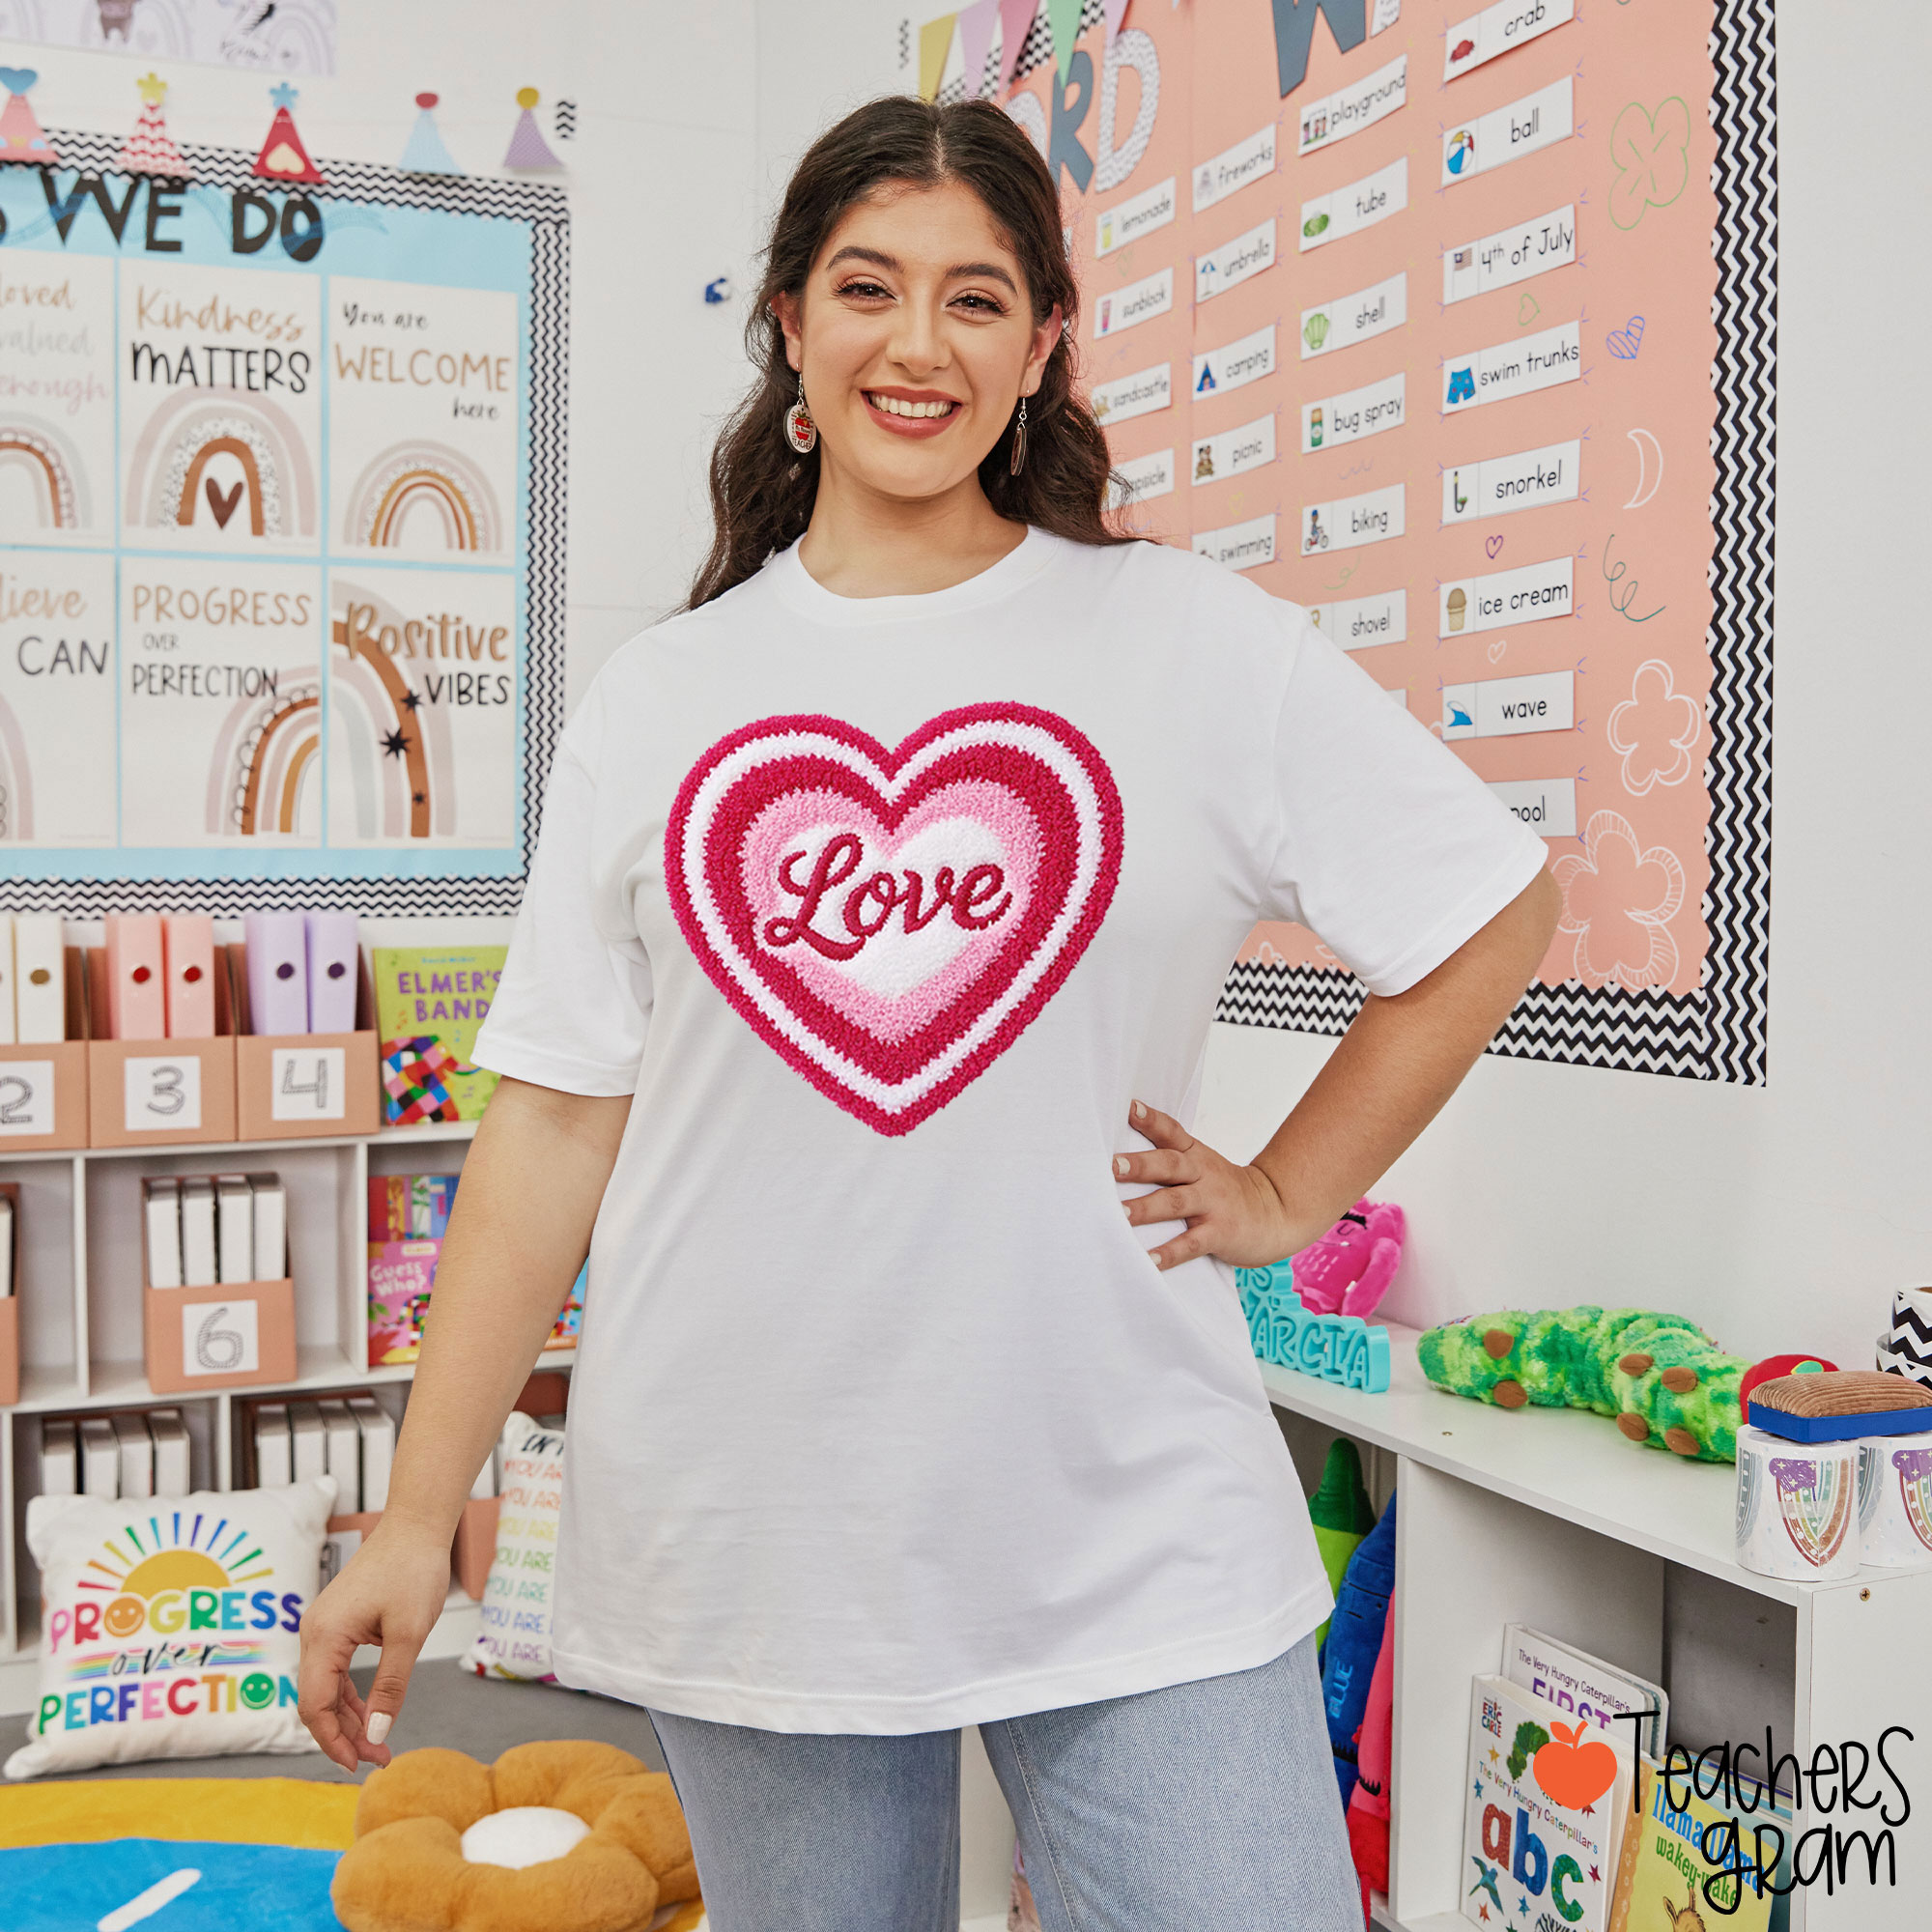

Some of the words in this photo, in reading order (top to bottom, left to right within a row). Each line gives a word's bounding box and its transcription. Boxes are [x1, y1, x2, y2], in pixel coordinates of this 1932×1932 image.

[1505, 0, 1546, 36] crab
[1331, 64, 1406, 131] playground
[1511, 106, 1540, 144] ball
[1218, 142, 1272, 187] fireworks
[39, 172, 186, 252] WE
[232, 191, 324, 262] DO
[1122, 192, 1172, 233] lemonade
[1356, 187, 1387, 217] tube
[1224, 238, 1270, 277] umbrella
[1482, 243, 1504, 273] 4th
[1511, 236, 1531, 266] of
[1537, 223, 1574, 255] July
[136, 286, 304, 342] Kindness
[343, 301, 385, 327] You
[395, 313, 430, 330] are
[1123, 282, 1166, 319] sunblock
[1356, 296, 1386, 329] shell
[131, 342, 310, 394] MATTERS
[335, 343, 512, 392] WELCOME
[1226, 349, 1269, 380] camping
[1480, 363, 1520, 387] swim
[1526, 340, 1578, 374] trunks
[452, 397, 499, 420] here
[1113, 373, 1169, 409] sandcastle
[1334, 410, 1360, 434] bug
[1364, 397, 1404, 427] spray
[1233, 440, 1264, 469] picnic
[1496, 459, 1561, 498] snorkel
[1351, 508, 1388, 533] biking
[1220, 535, 1272, 562] swimming
[133, 584, 312, 626] PROGRESS
[1479, 597, 1503, 616] ice
[1510, 584, 1569, 611] cream
[347, 603, 509, 662] Positive
[1351, 606, 1391, 637] shovel
[17, 636, 108, 676] CAN
[143, 633, 179, 651] OVER
[132, 664, 278, 697] PERFECTION
[425, 671, 511, 705] VIBES
[1502, 700, 1548, 720] wave
[764, 833, 1012, 962] Love
[415, 998, 490, 1023] BAND
[0, 1076, 33, 1124] 2
[147, 1065, 186, 1116] 3
[281, 1059, 328, 1110] 4
[370, 1261, 423, 1283] Guess
[375, 1274, 428, 1297] Who?
[196, 1306, 242, 1370] 6
[1248, 1304, 1372, 1388] ARCIA
[50, 1590, 302, 1654] PROGRESS
[112, 1641, 242, 1676] over
[1328, 1660, 1353, 1719] BLUE
[1519, 1648, 1531, 1665] The
[1533, 1656, 1549, 1677] Very
[1550, 1665, 1579, 1691] Hungry
[1580, 1680, 1631, 1715] Caterpillar's
[39, 1672, 298, 1736] PERFECTION
[1482, 1701, 1502, 1725] ERIC
[1481, 1715, 1502, 1739] CARLE
[1479, 1760, 1492, 1779] The
[1494, 1772, 1513, 1797] Very
[1513, 1786, 1543, 1819] Hungry
[1544, 1808, 1598, 1855] Caterpillar's
[1482, 1803, 1584, 1922] abc
